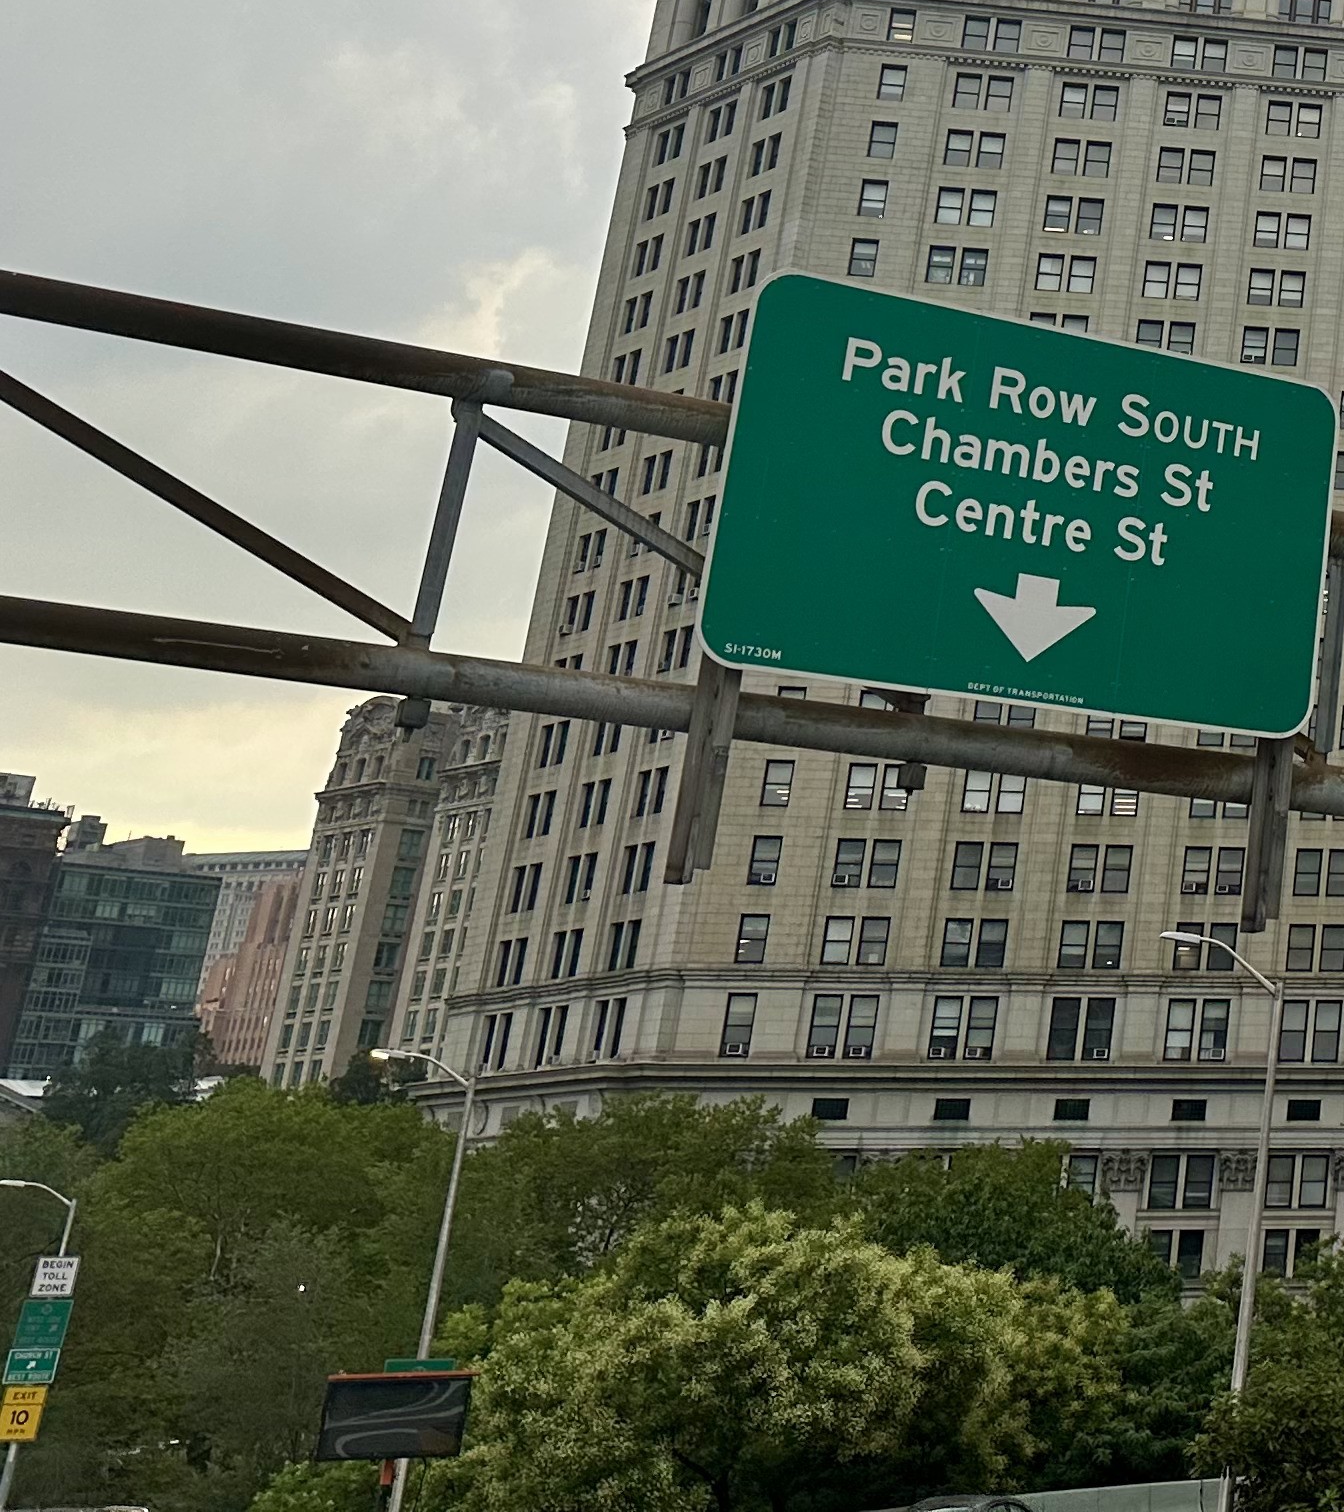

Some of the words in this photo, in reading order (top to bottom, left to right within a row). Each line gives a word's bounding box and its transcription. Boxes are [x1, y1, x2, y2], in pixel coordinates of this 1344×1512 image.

[842, 337, 965, 402] Park
[990, 367, 1096, 426] Row
[1118, 394, 1259, 460] SOUTH
[882, 410, 1139, 497] Chambers
[1161, 464, 1213, 511] St
[916, 481, 1091, 552] Centre
[1114, 517, 1167, 565] St
[724, 643, 782, 660] SI-1730M
[967, 682, 991, 693] DEPT
[992, 685, 1005, 694] OF
[1007, 687, 1084, 704] TRANSPORTATION
[42, 1260, 74, 1268] BEGIN
[43, 1272, 67, 1280] TOLL
[38, 1284, 67, 1292] ZONE
[13, 1391, 38, 1400] EXIT
[10, 1410, 29, 1425] 10
